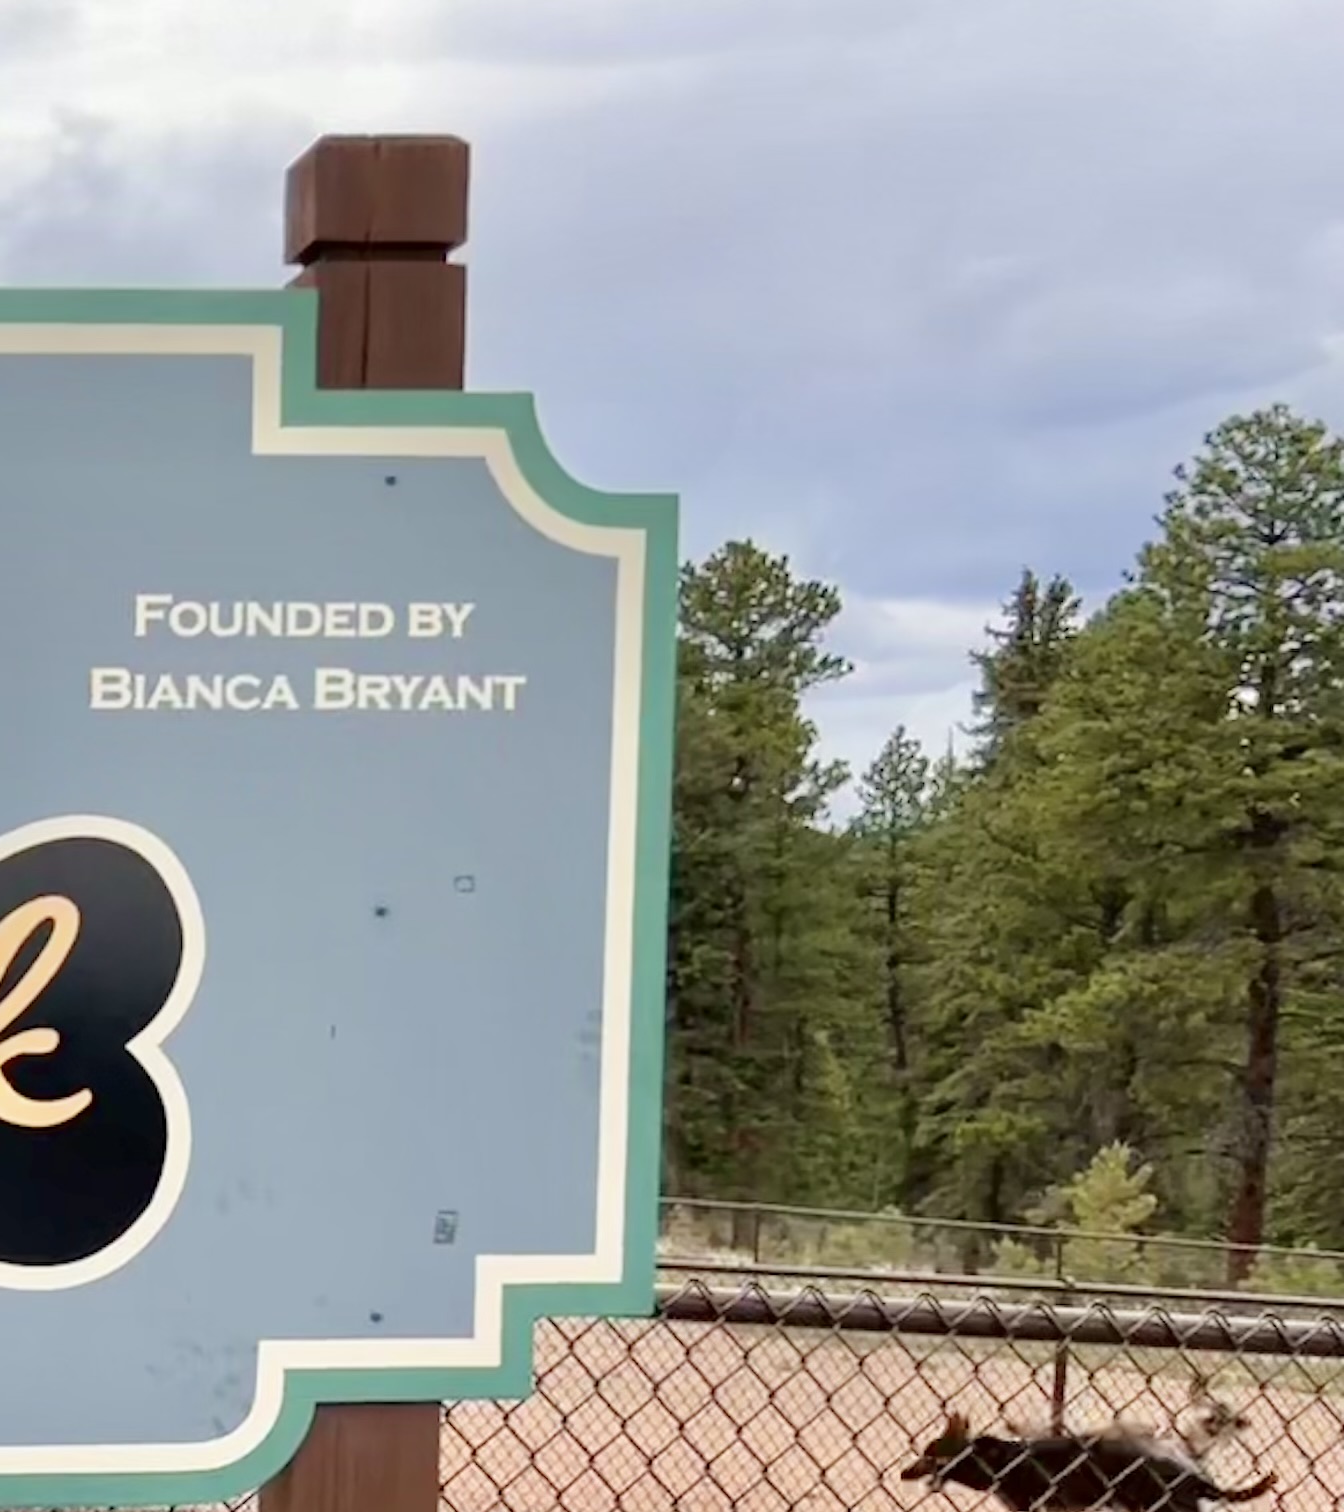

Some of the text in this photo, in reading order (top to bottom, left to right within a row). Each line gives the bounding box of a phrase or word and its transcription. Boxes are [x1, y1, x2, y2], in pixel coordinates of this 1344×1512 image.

[135, 594, 473, 637] FOUNDED BY
[91, 668, 526, 710] BIANCA BRYANT
